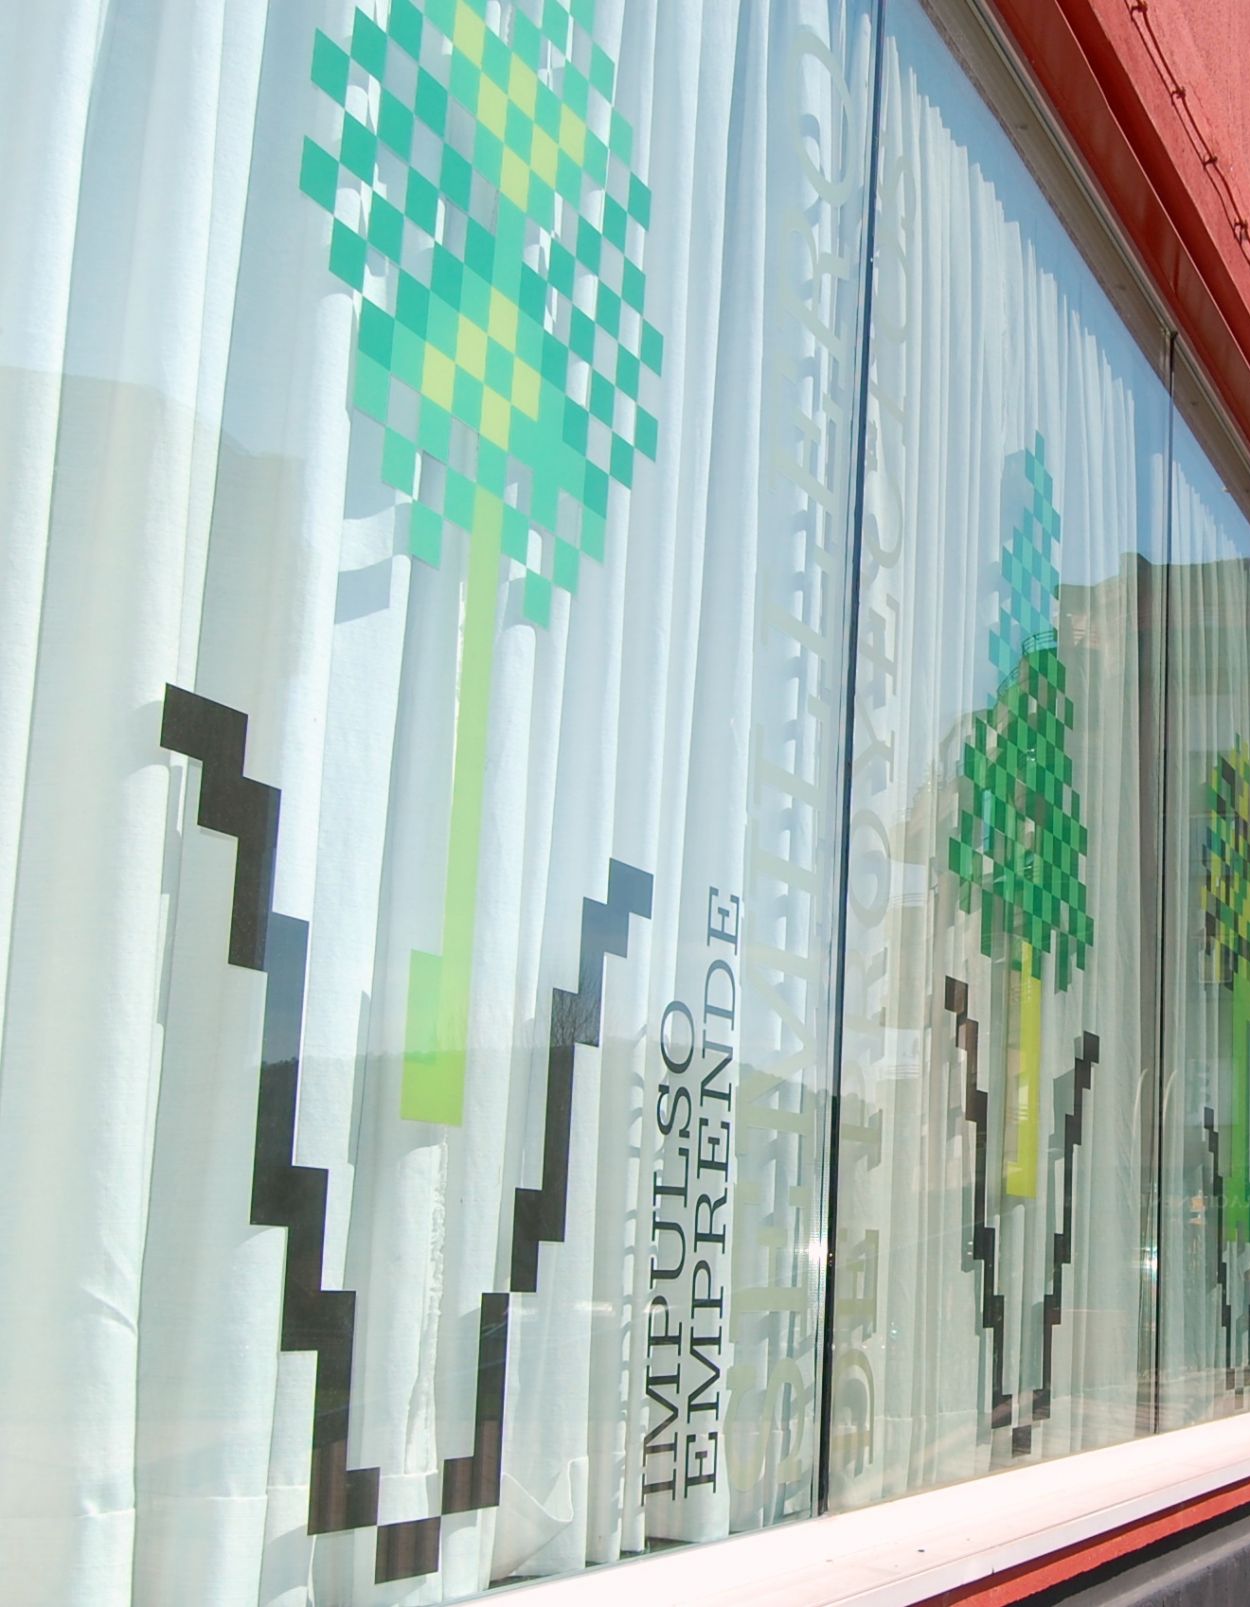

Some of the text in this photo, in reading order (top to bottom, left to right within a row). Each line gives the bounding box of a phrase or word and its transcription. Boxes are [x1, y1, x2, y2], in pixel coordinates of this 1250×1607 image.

[723, 28, 854, 1490] SEMILLERO
[641, 1000, 695, 1506] IMPULSO
[684, 885, 740, 1499] EMPRENDE
